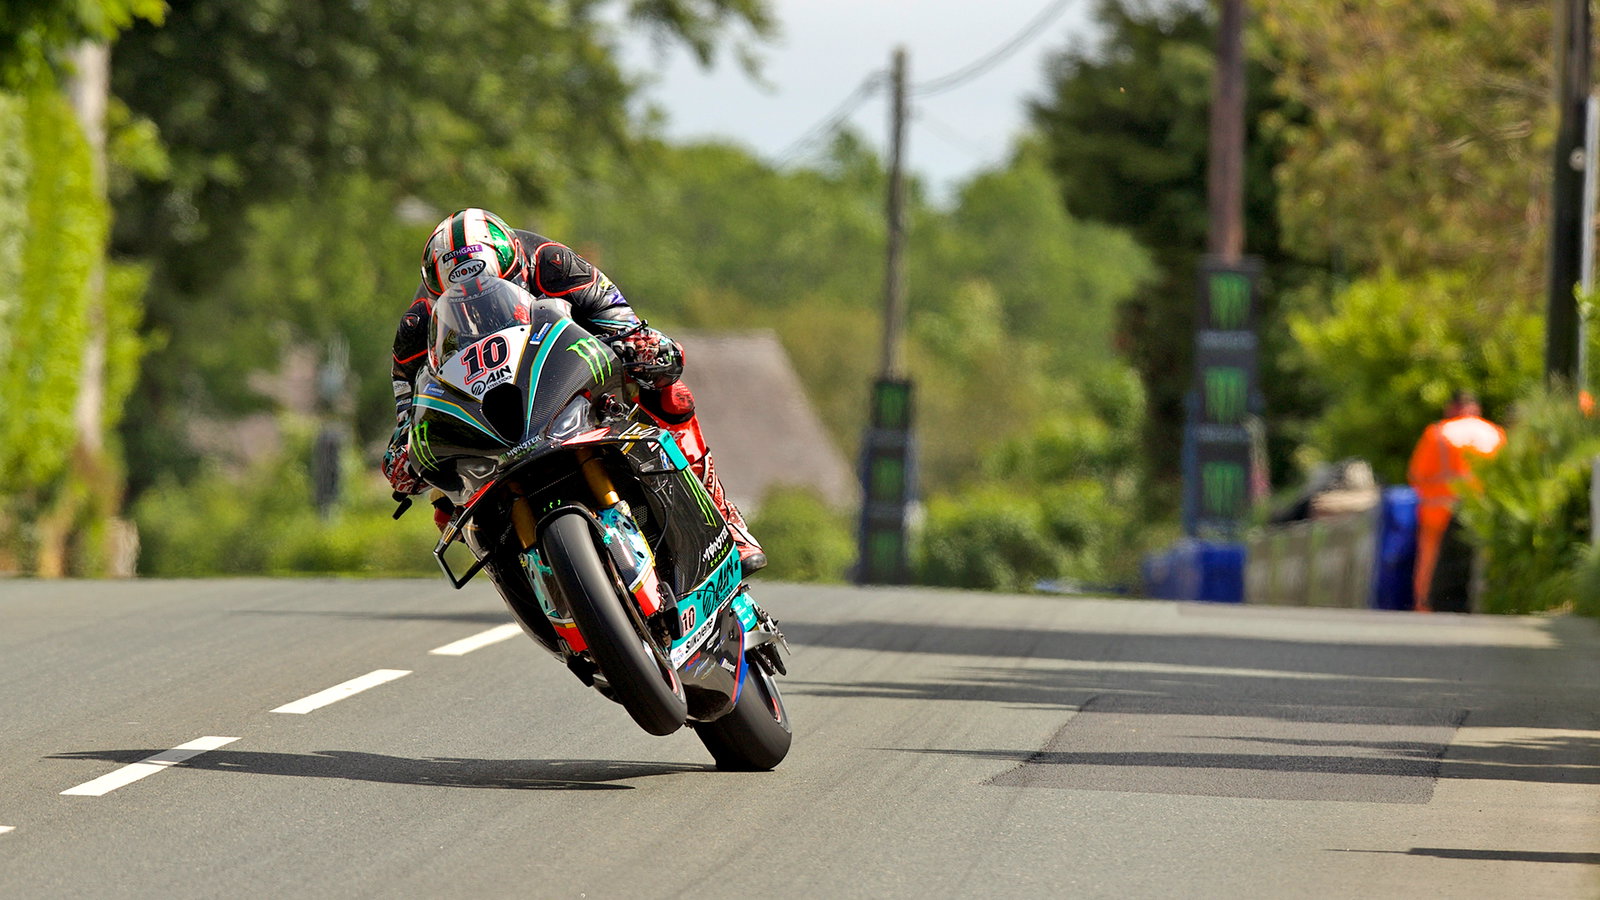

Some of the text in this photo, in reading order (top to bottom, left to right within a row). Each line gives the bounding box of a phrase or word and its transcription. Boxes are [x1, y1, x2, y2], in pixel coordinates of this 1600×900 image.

[444, 245, 480, 260] BATHGATE
[450, 263, 482, 280] SUOMY
[461, 334, 510, 384] 10
[506, 434, 542, 458] MONSTER
[710, 543, 729, 568] ENERGY
[681, 605, 696, 635] 10
